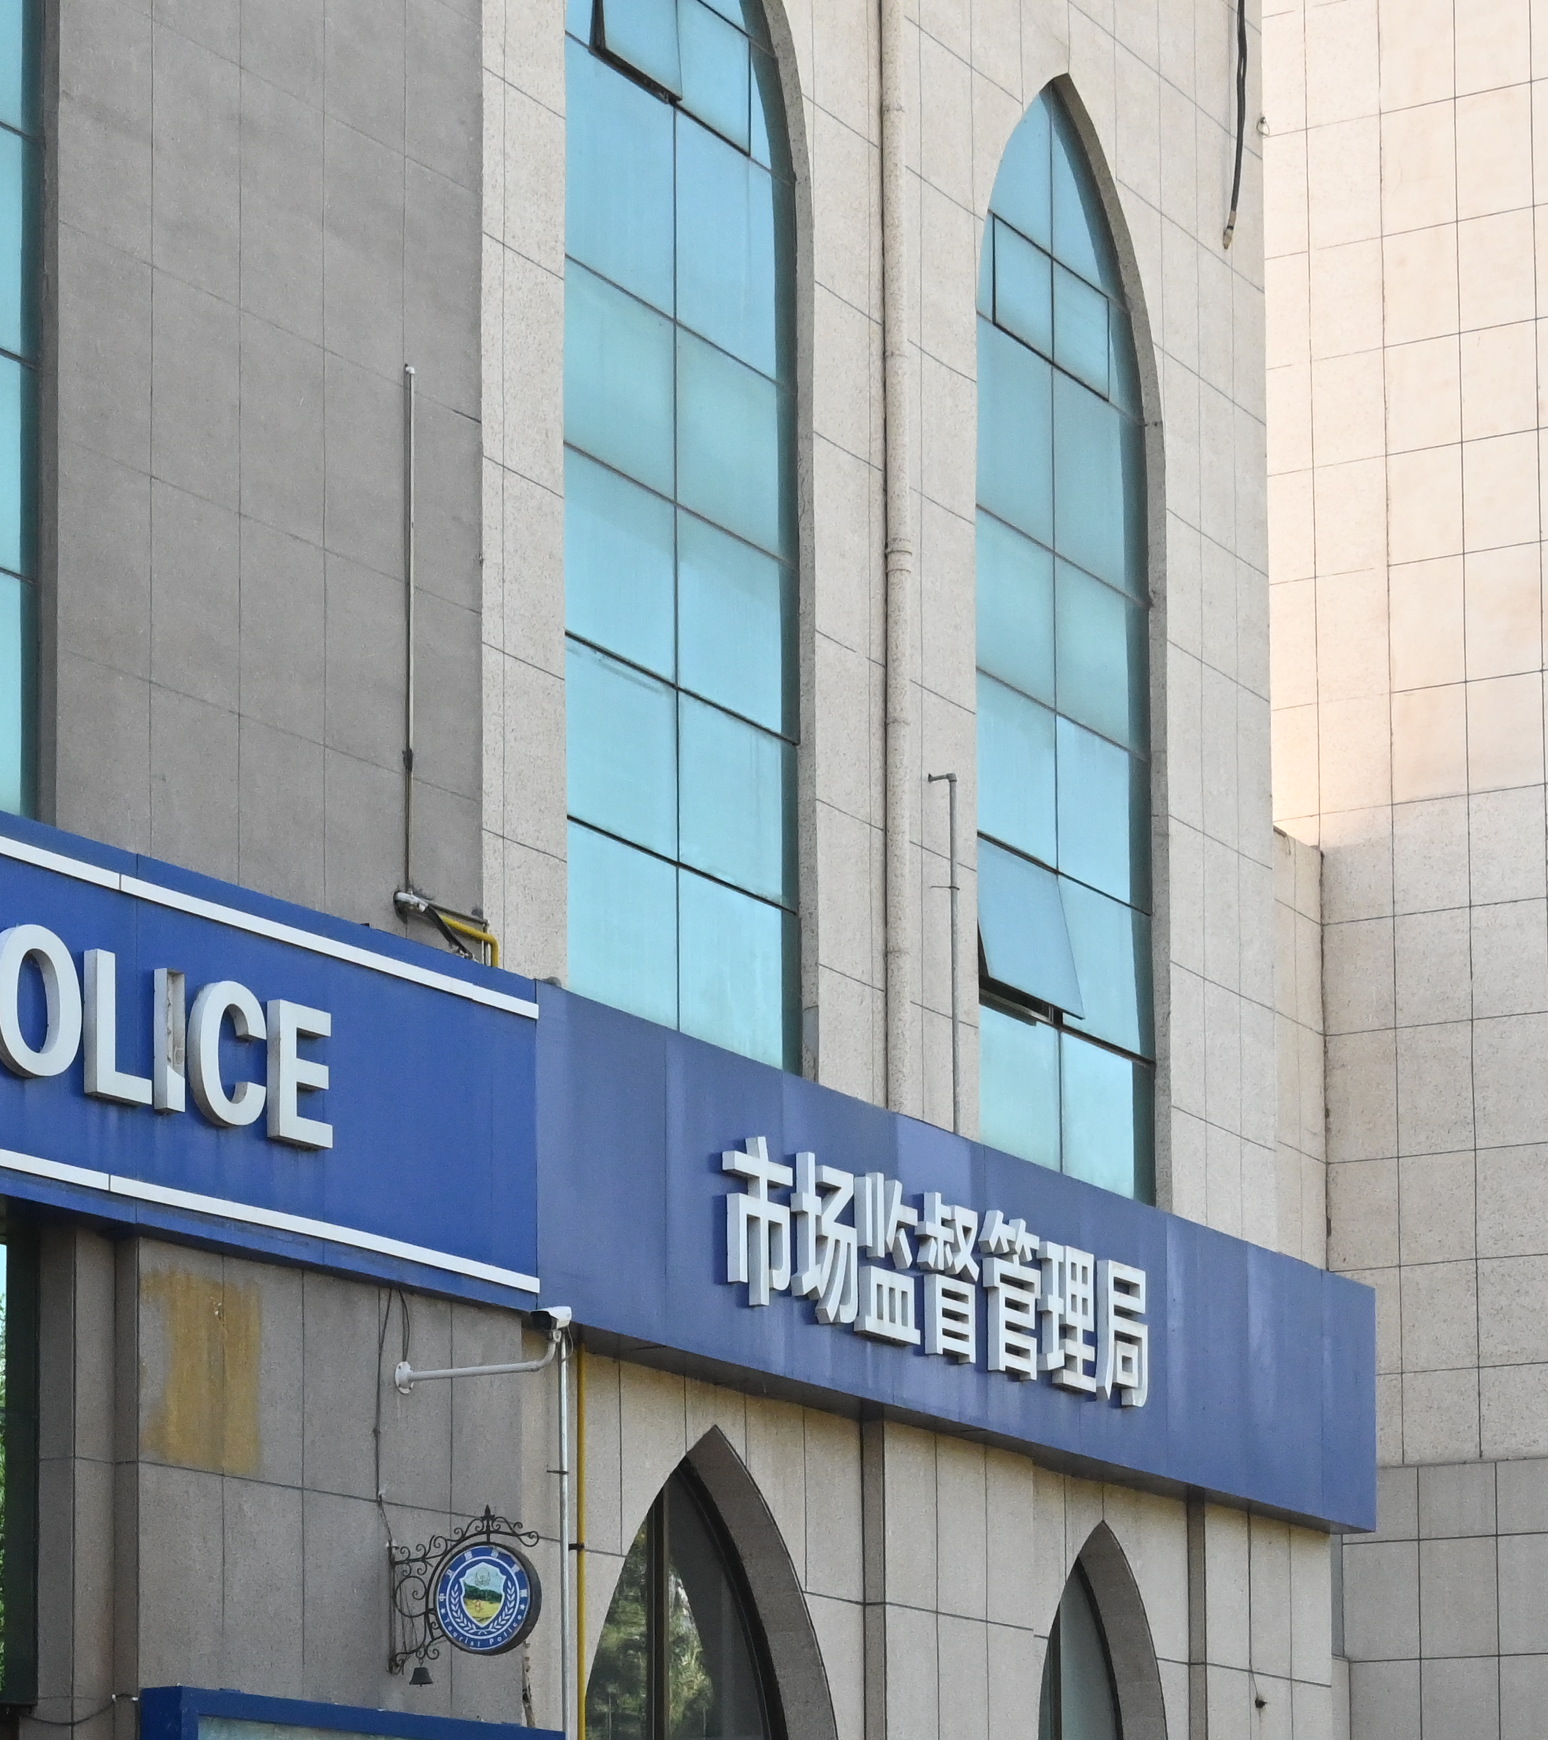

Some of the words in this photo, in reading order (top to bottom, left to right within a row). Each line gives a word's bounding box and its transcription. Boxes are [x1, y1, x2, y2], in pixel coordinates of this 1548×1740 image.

[722, 1136, 1150, 1408] 市场监督管理局
